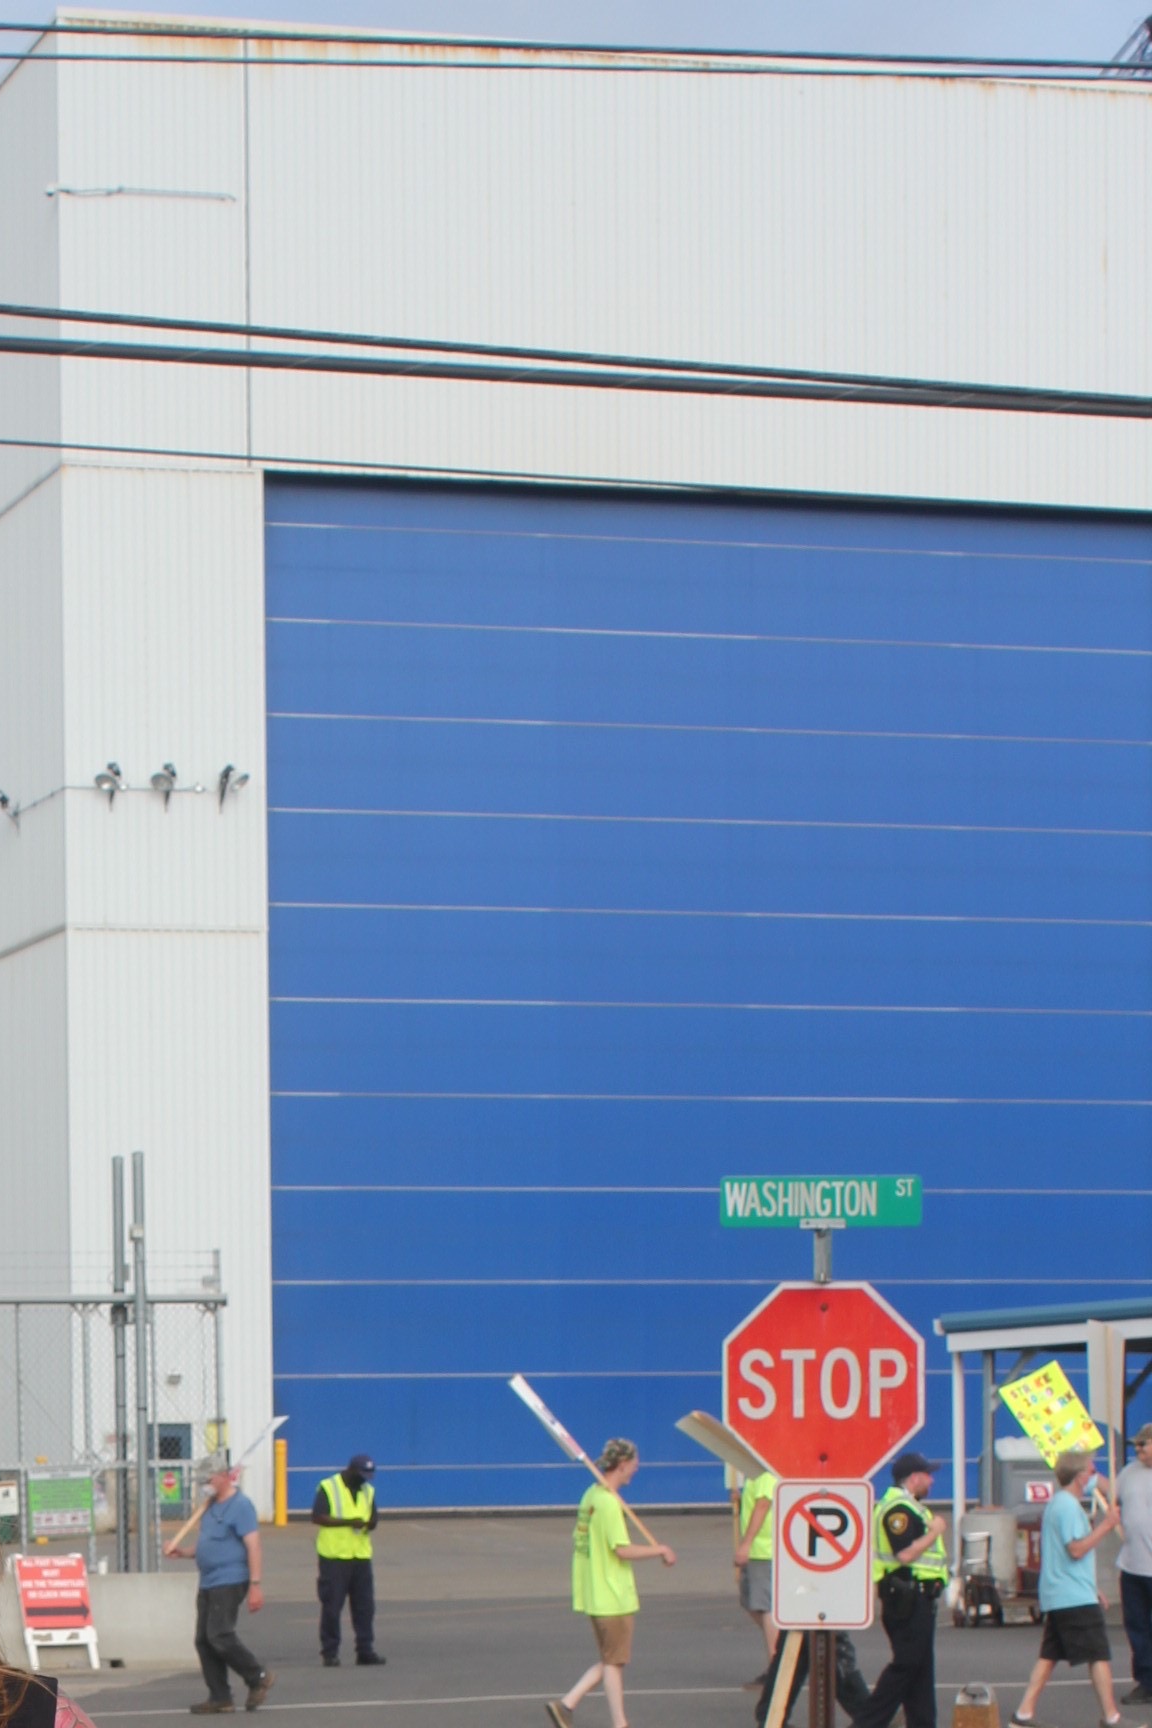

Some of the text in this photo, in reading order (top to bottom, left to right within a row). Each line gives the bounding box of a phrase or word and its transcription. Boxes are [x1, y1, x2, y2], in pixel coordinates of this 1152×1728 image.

[724, 1178, 915, 1218] WASHINGTON ST
[737, 1347, 908, 1420] STOP
[1010, 1371, 1054, 1400] STRKE
[808, 1507, 849, 1557] P
